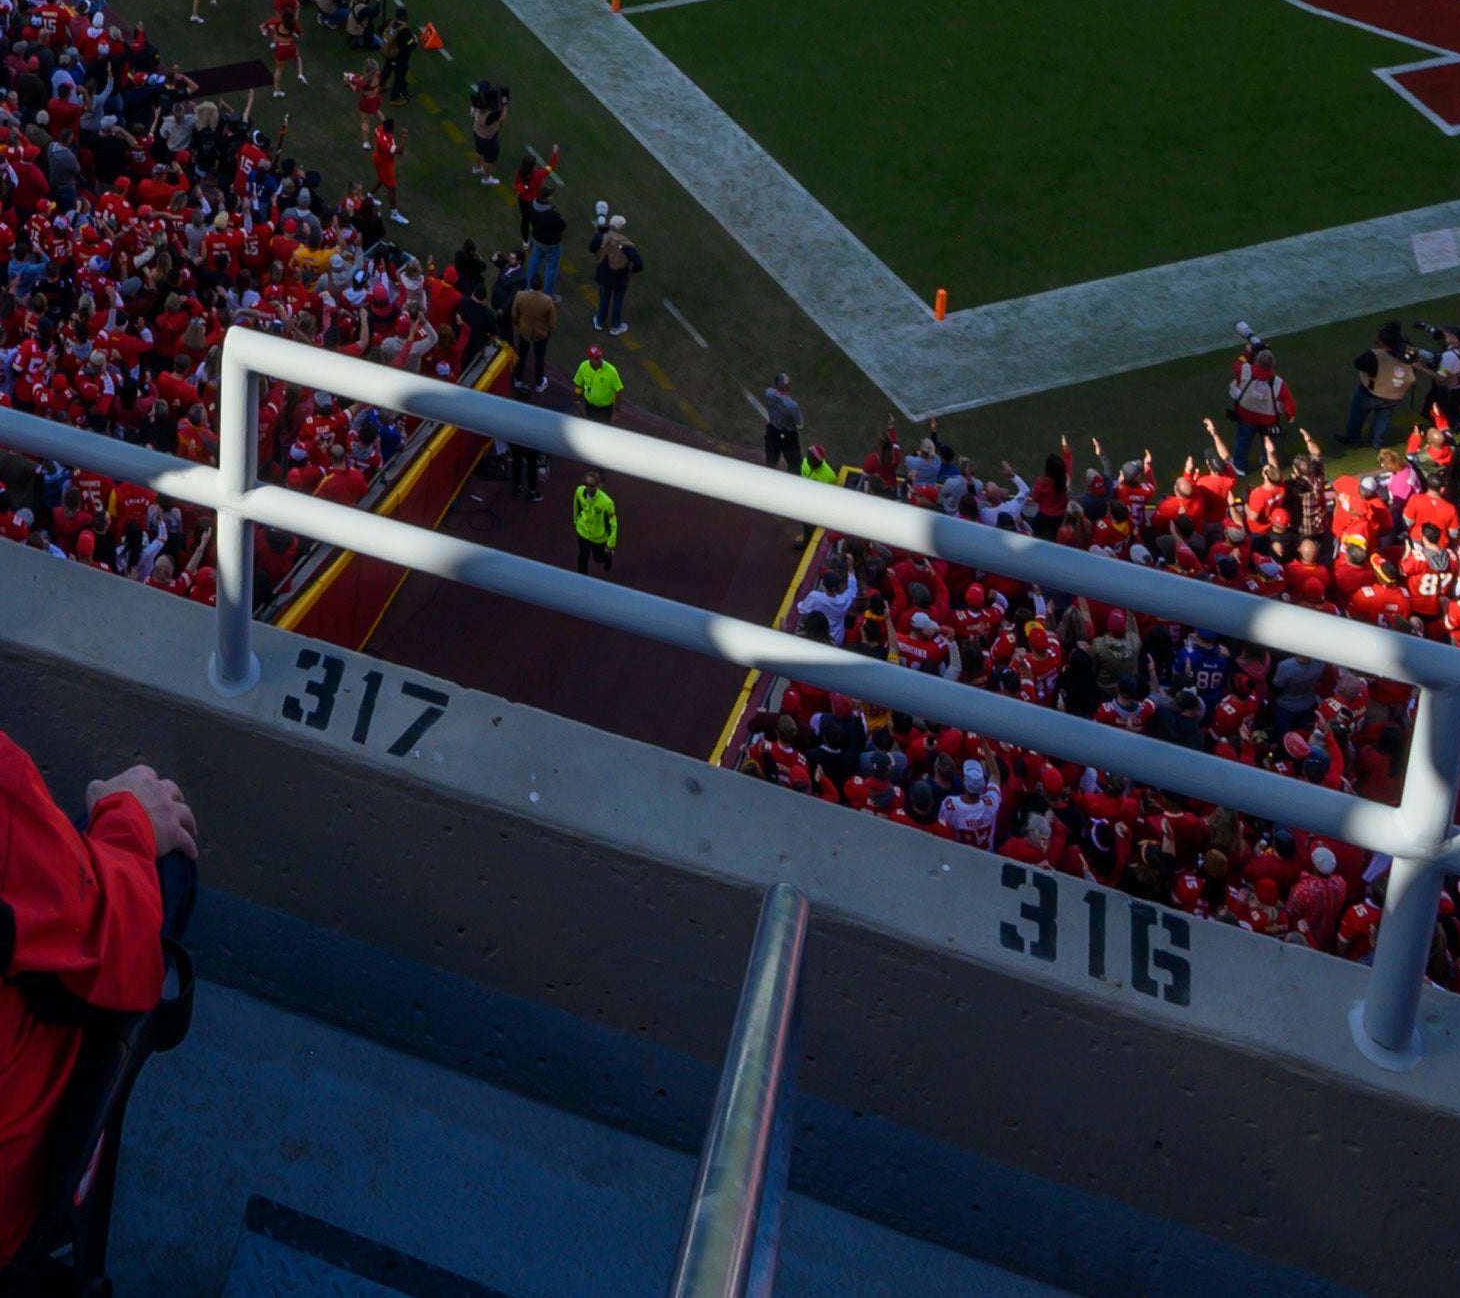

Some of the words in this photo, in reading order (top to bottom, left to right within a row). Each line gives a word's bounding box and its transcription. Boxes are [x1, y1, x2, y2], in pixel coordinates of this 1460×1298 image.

[1420, 572, 1452, 596] 87
[280, 647, 451, 758] 317
[1195, 670, 1221, 690] 88
[997, 860, 1192, 1006] 316
